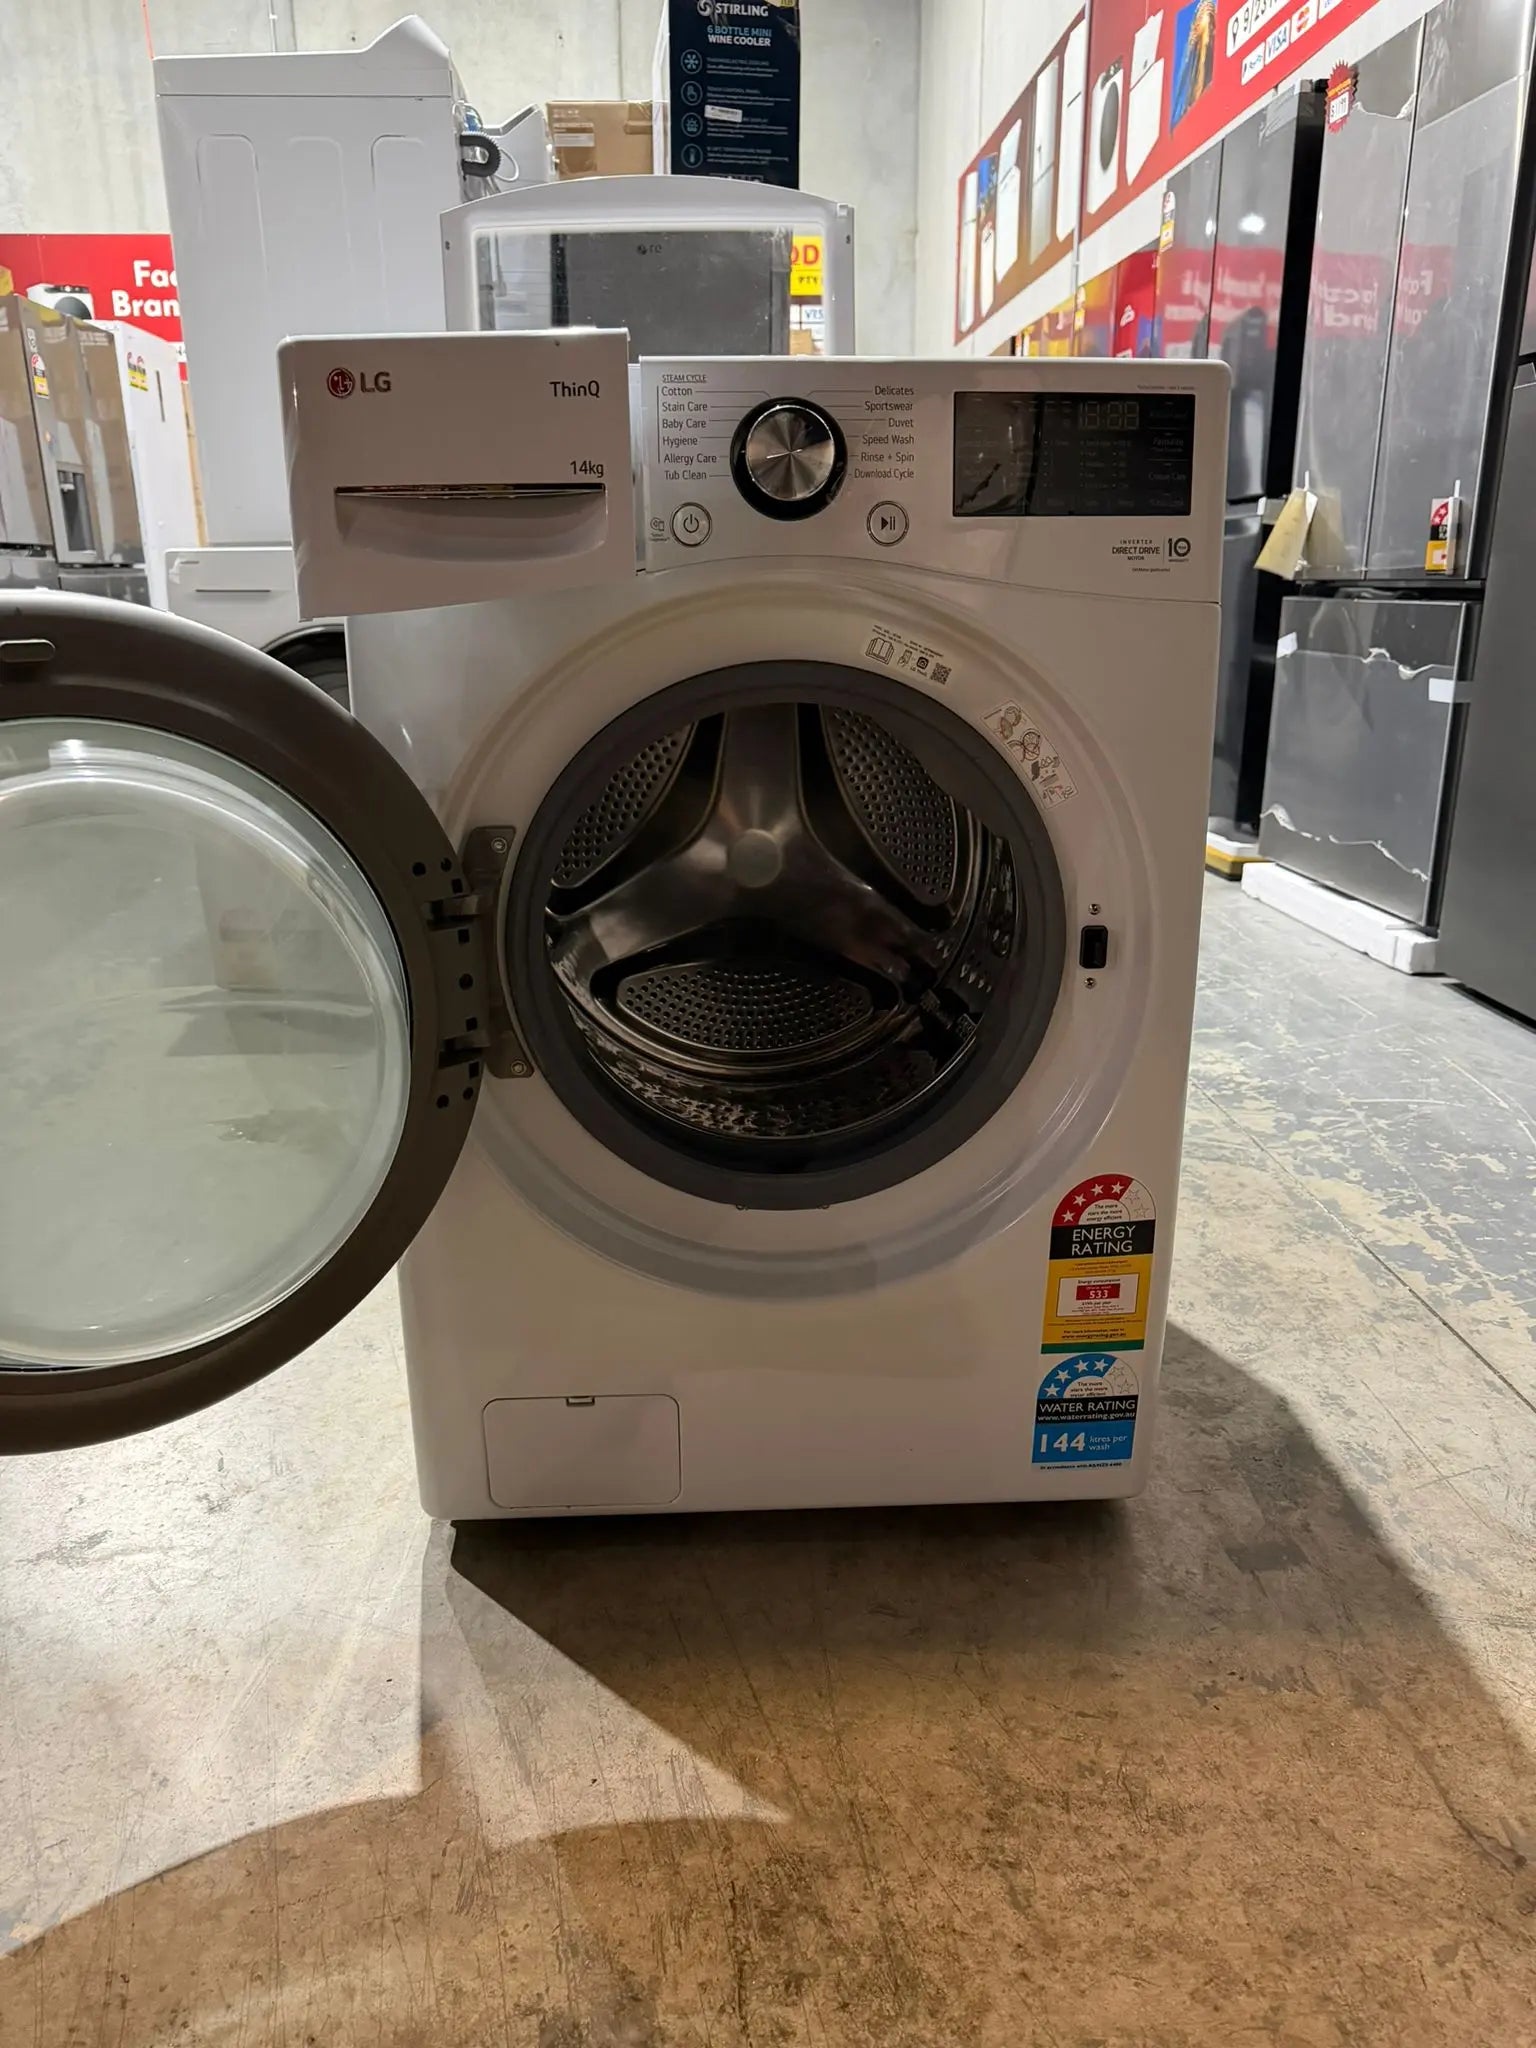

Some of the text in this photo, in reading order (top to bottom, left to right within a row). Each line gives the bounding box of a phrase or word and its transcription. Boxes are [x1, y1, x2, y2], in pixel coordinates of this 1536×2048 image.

[716, 4, 768, 16] STIRLING
[707, 26, 772, 37] 6 BOTTLE MINI
[708, 35, 771, 46] WINE COOLER
[360, 372, 392, 393] LG
[662, 374, 707, 383] STEAM CYCLE
[549, 380, 600, 398] ThinQ
[661, 386, 693, 396] Cotton
[875, 386, 914, 395] Delicates
[662, 402, 708, 412] Stain Care
[865, 401, 913, 413] Sportswear
[662, 419, 707, 431] Baby Care
[888, 418, 914, 428] Duvet
[662, 436, 698, 448] Hygiene
[862, 435, 914, 446] Speed Wash
[664, 453, 717, 466] Allergy Care
[861, 452, 884, 462] Rinse
[895, 452, 914, 464] Spin
[570, 460, 605, 478] 14kg
[854, 469, 914, 480] Download Cycle
[665, 470, 707, 480] Tub Clean
[1112, 546, 1160, 555] DIRECT DRIVE
[1073, 1225, 1136, 1242] ENERGY
[1072, 1240, 1133, 1256] RATING
[1089, 1290, 1109, 1299] 533
[1040, 1400, 1136, 1413] WATER RATING
[1038, 1412, 1136, 1421] www.waterrating.gov.au
[1040, 1432, 1086, 1453] 144
[1113, 1435, 1127, 1444] per
